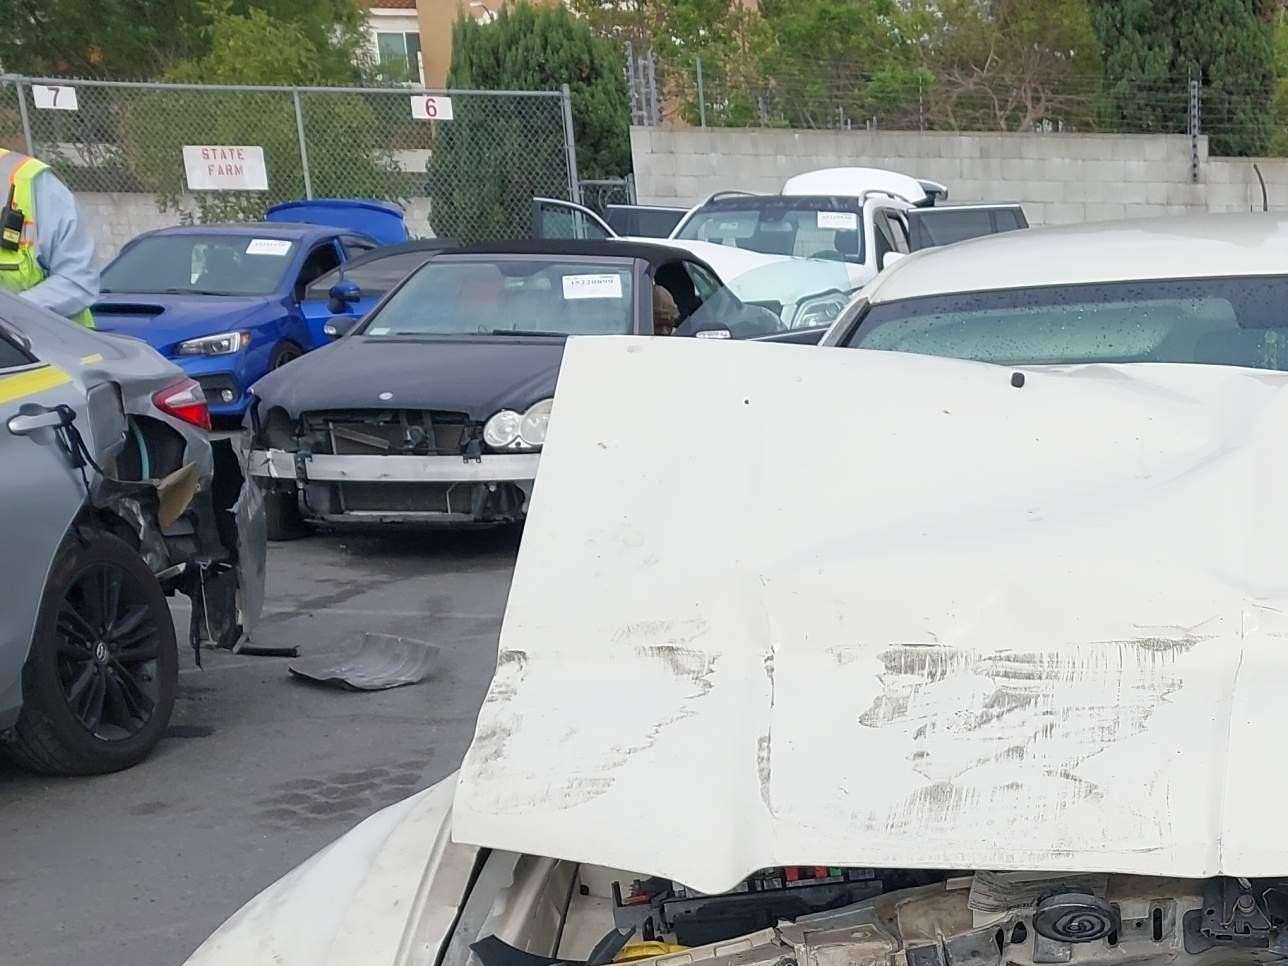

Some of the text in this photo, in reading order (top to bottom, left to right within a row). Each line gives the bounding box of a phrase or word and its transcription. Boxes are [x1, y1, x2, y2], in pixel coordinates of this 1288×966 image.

[47, 87, 60, 107] 7
[425, 98, 437, 117] 6
[201, 148, 245, 160] STATE
[207, 164, 243, 176] FARM
